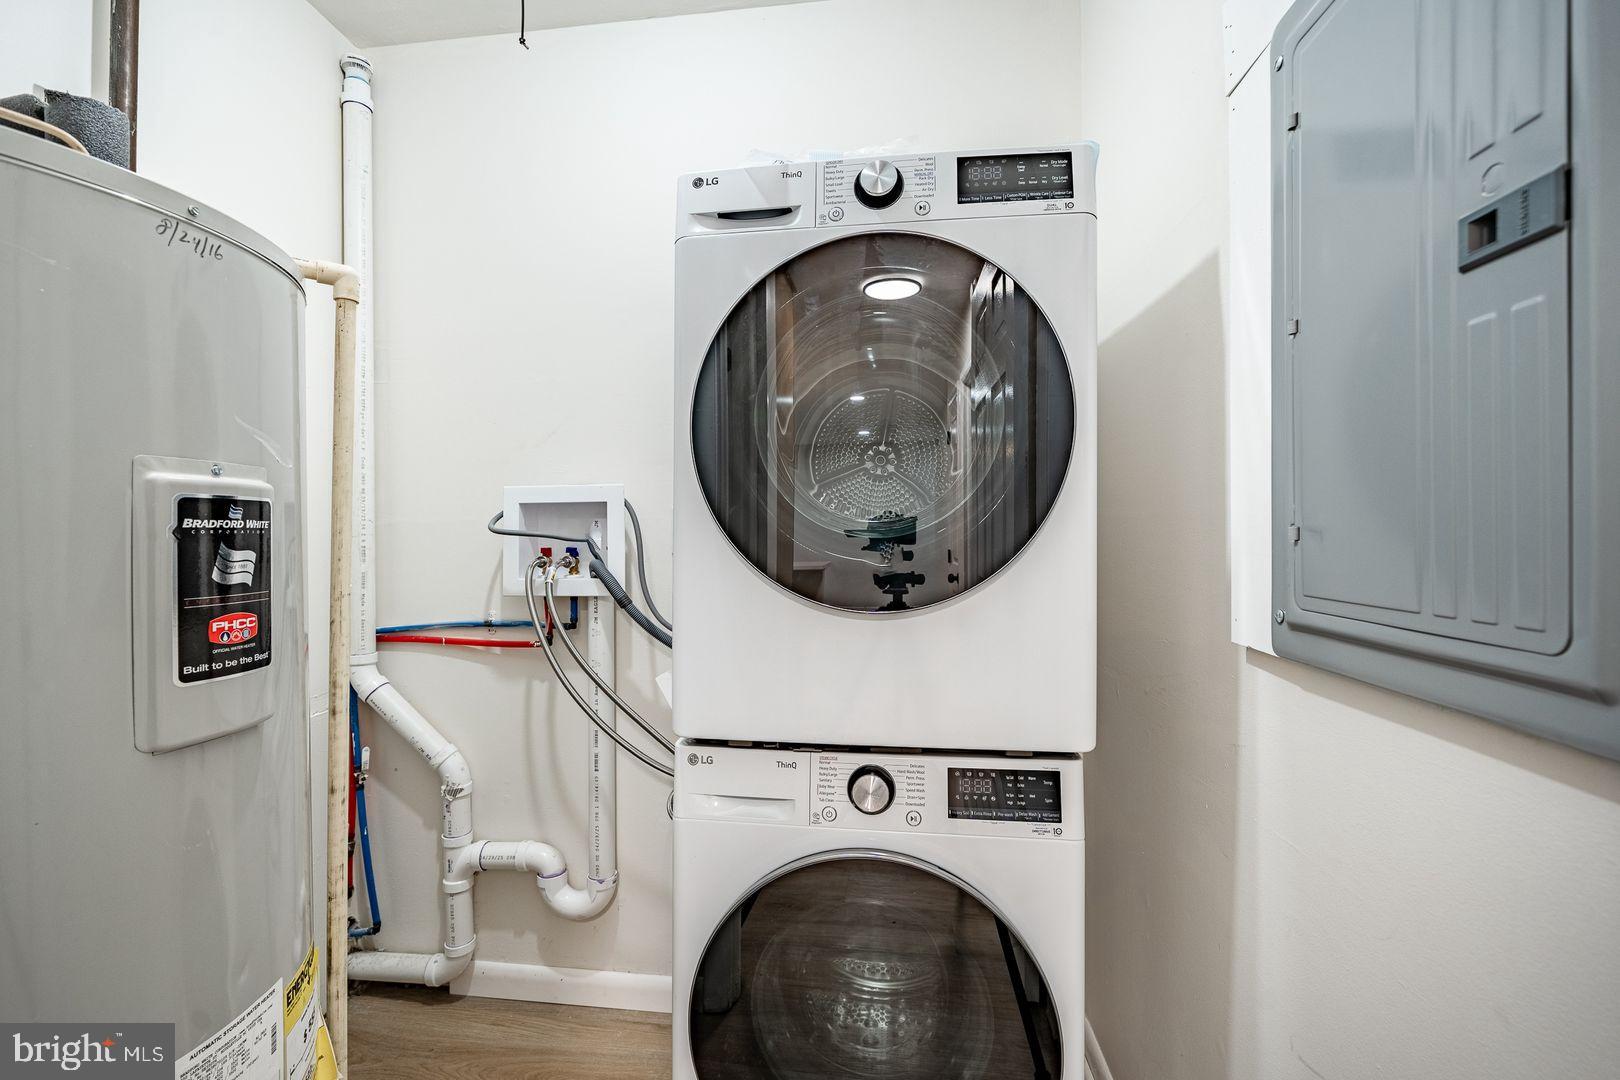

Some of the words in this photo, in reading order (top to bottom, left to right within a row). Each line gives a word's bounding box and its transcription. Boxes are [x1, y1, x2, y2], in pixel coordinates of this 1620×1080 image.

[780, 170, 802, 179] ThinQ
[705, 177, 719, 186] LG
[182, 518, 244, 529] BRADFORD
[246, 519, 270, 529] WHITE
[212, 617, 256, 632] PHCC
[183, 663, 210, 675] Built
[211, 661, 223, 670] to
[225, 658, 238, 668] be
[240, 655, 253, 664] the
[254, 652, 268, 661] Best
[700, 756, 713, 764] LG
[776, 761, 797, 769] ThinQ
[190, 1034, 222, 1061] AUTOMATIC
[223, 1015, 246, 1037] STORAGE
[246, 1003, 260, 1017] WATER
[261, 989, 275, 1004] HEATER
